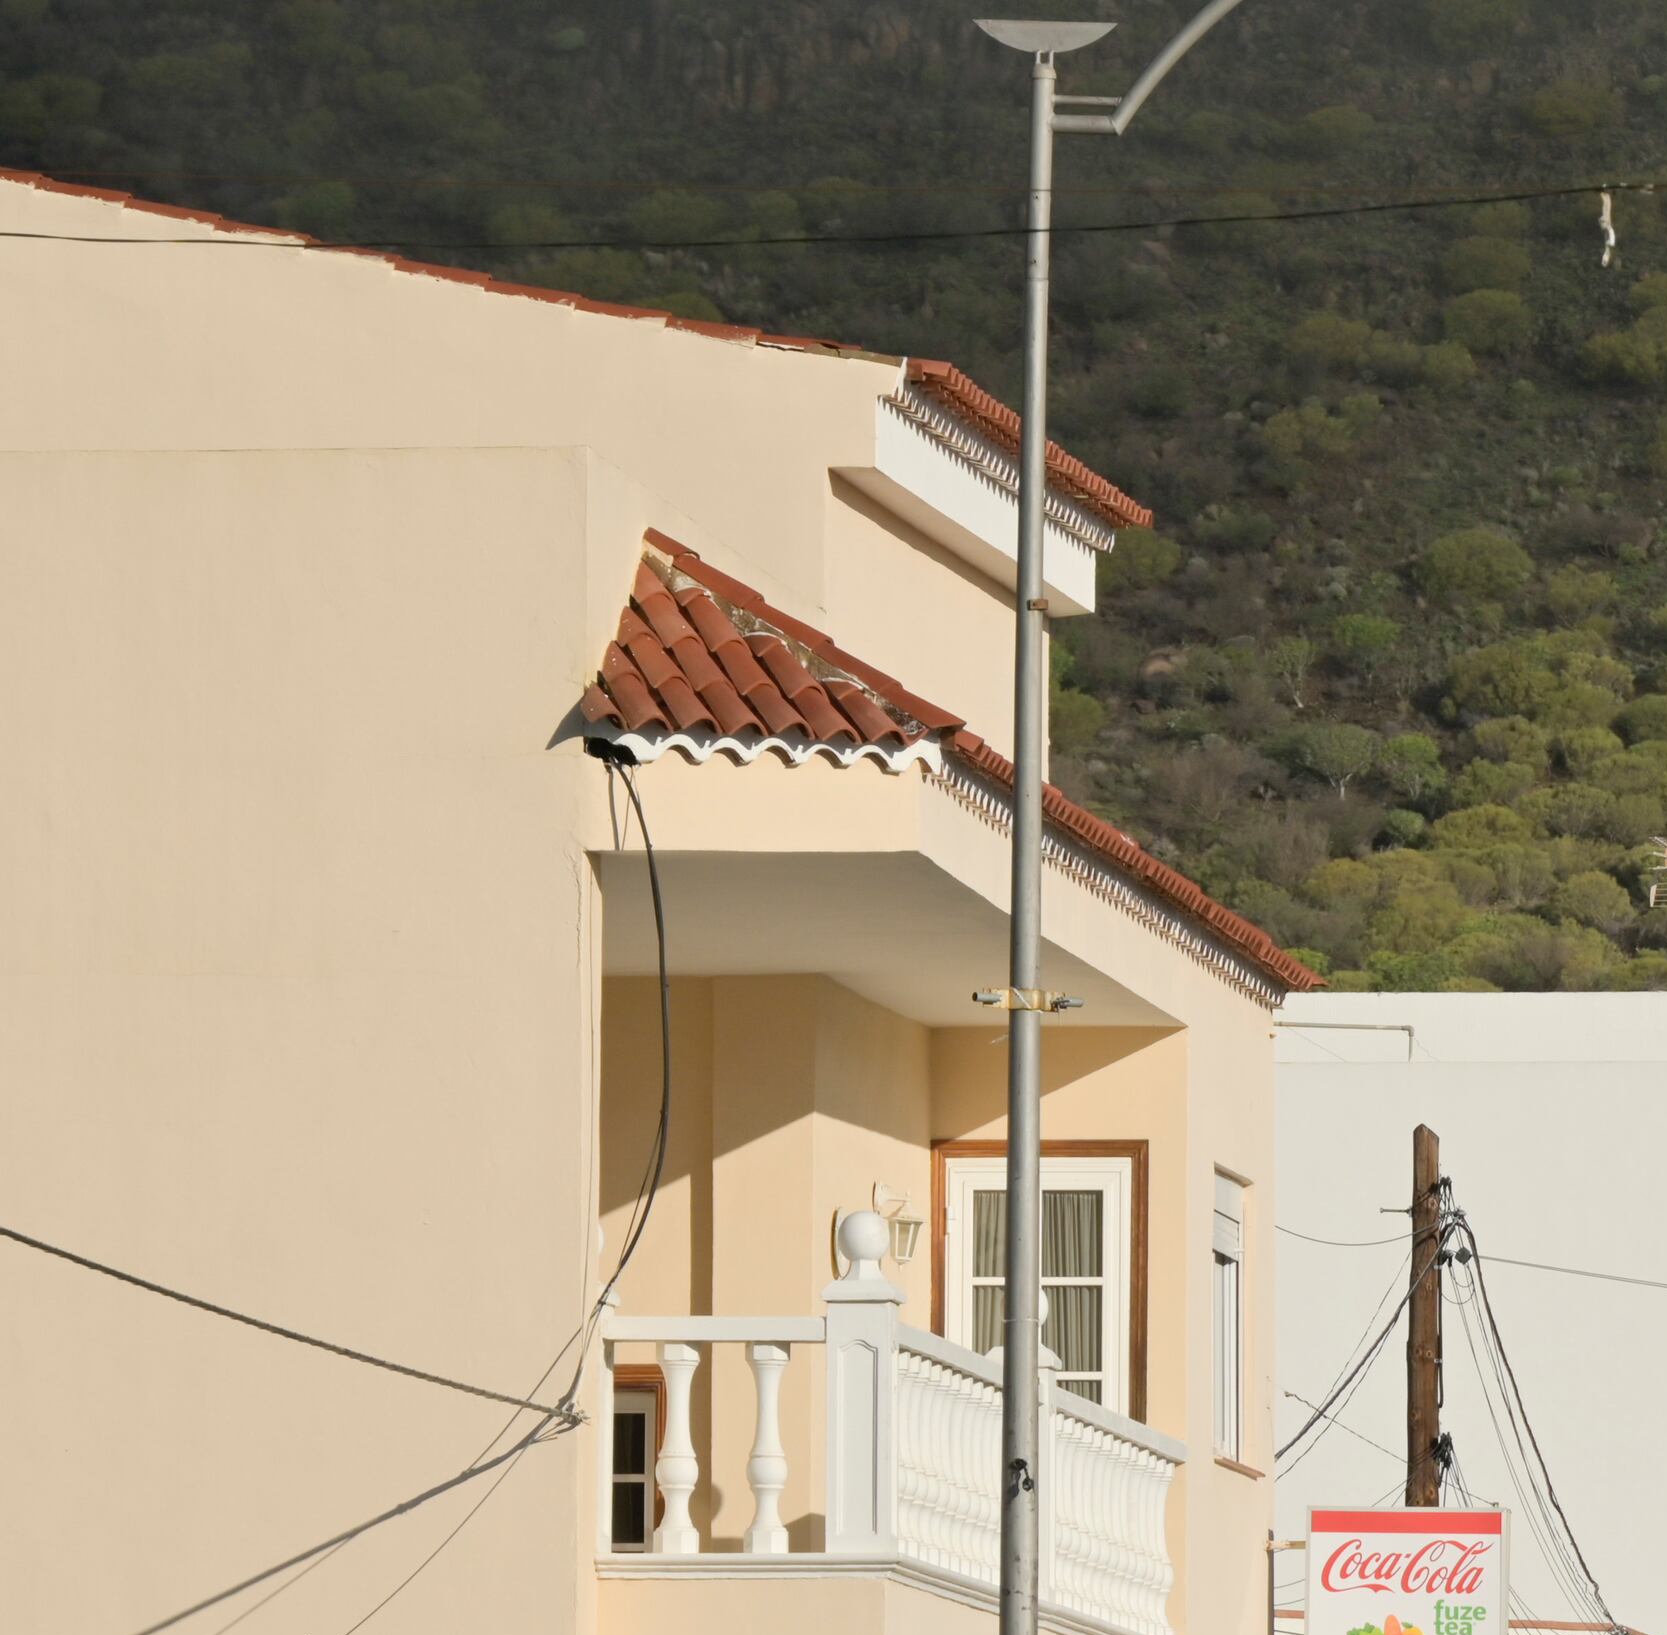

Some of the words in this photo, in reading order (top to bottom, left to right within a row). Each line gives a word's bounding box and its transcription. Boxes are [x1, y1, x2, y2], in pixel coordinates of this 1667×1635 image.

[1321, 1539, 1496, 1594] Coca-Cola
[1434, 1599, 1487, 1621] fuze
[1434, 1618, 1474, 1635] tea
